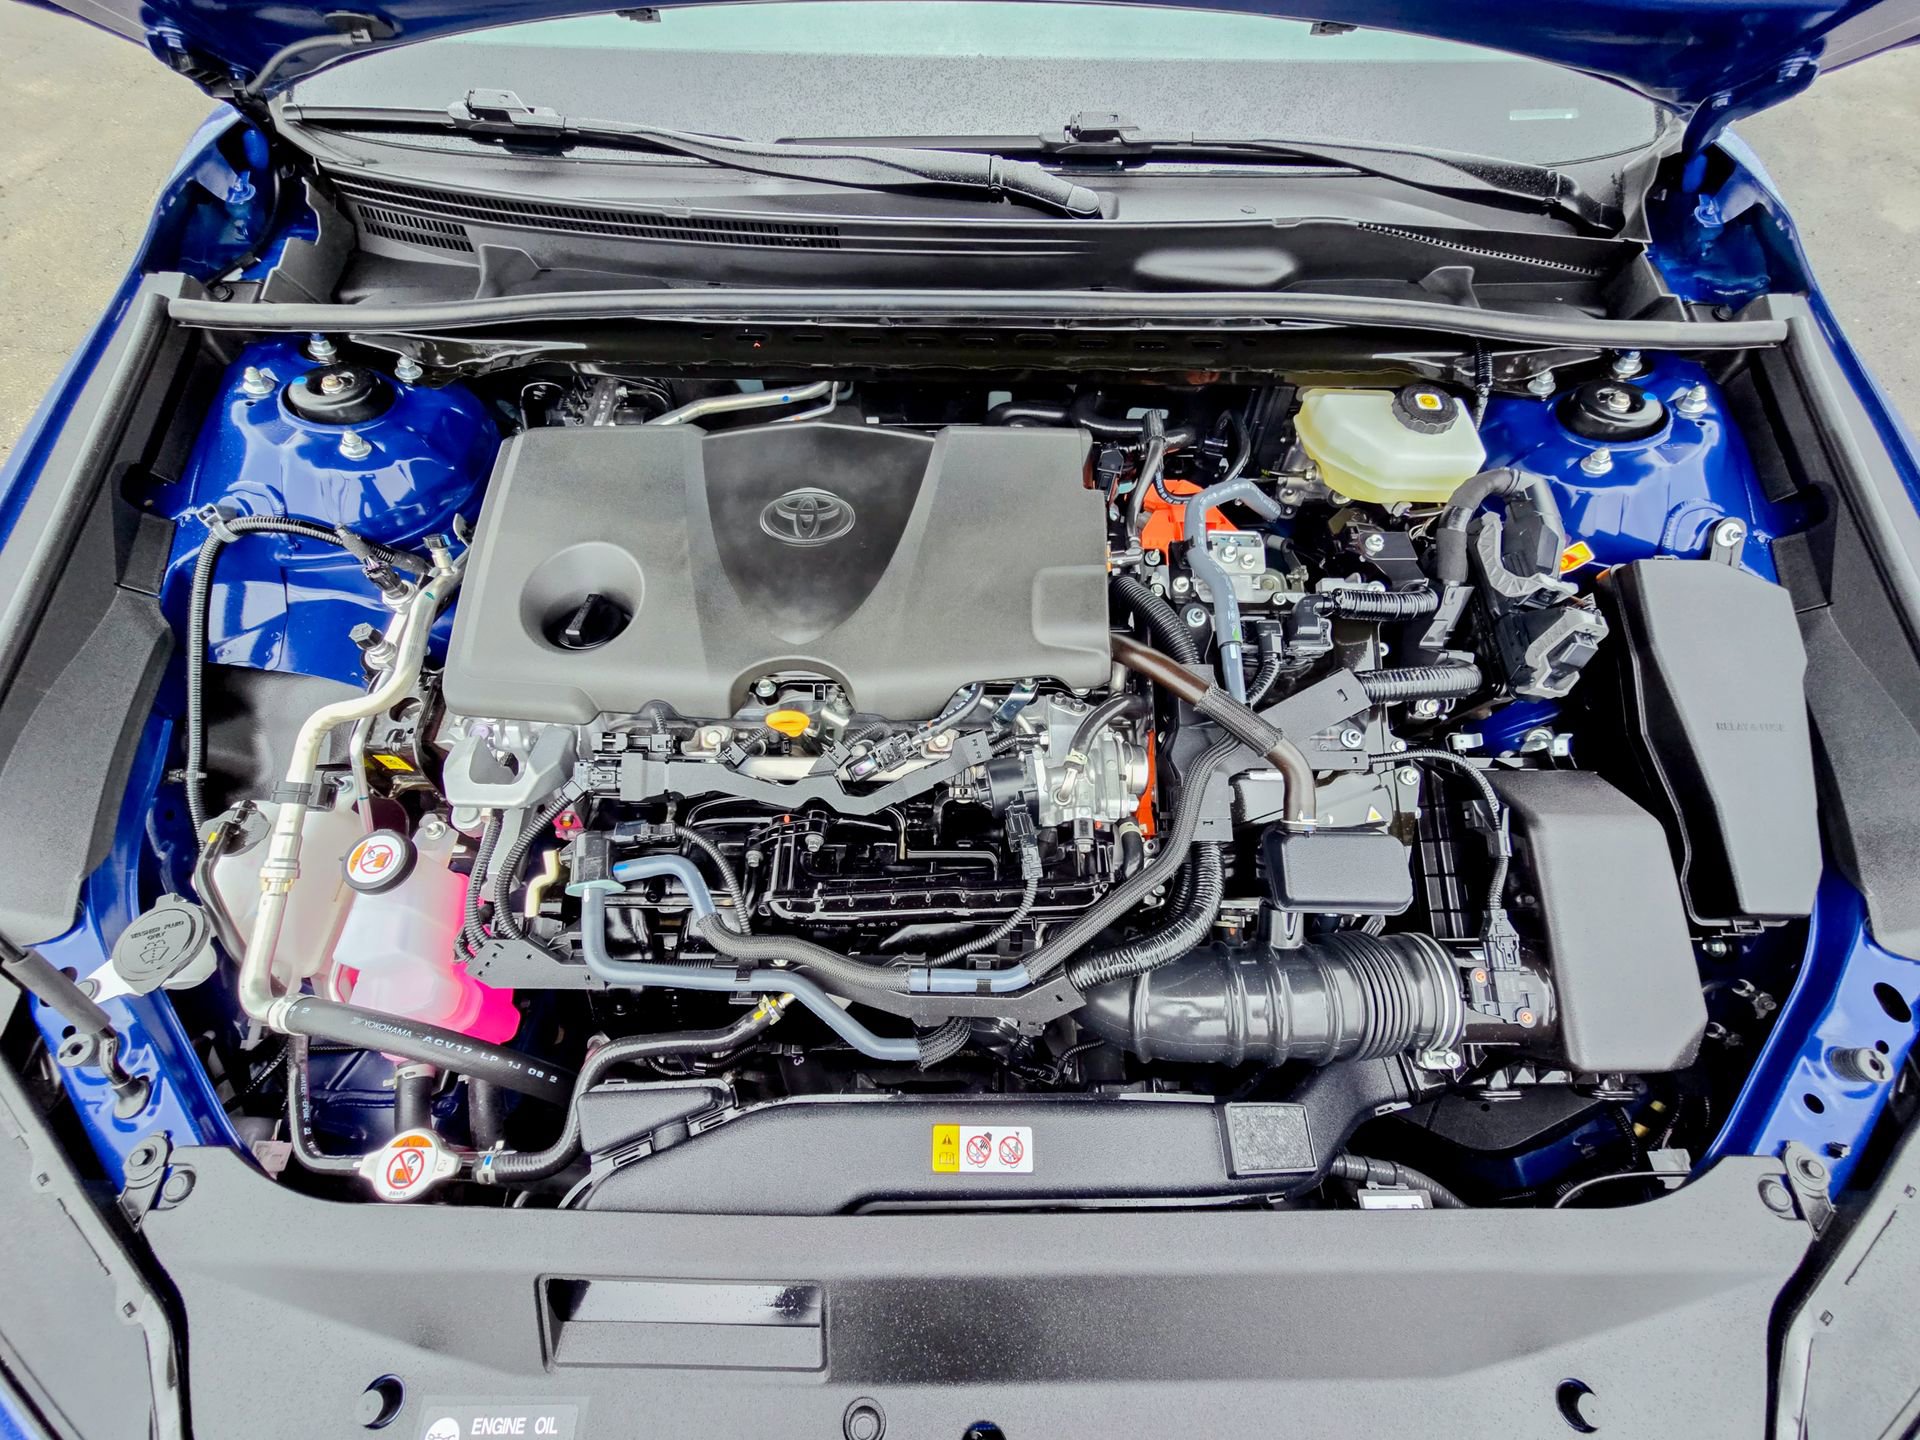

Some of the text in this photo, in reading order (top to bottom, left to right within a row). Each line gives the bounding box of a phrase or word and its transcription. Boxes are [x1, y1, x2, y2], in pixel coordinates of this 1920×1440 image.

[363, 1019, 412, 1038] YOKOHAMA
[422, 1035, 473, 1054] ACV17
[549, 1075, 559, 1084] 2
[471, 1416, 558, 1435] ENGINE OIL
